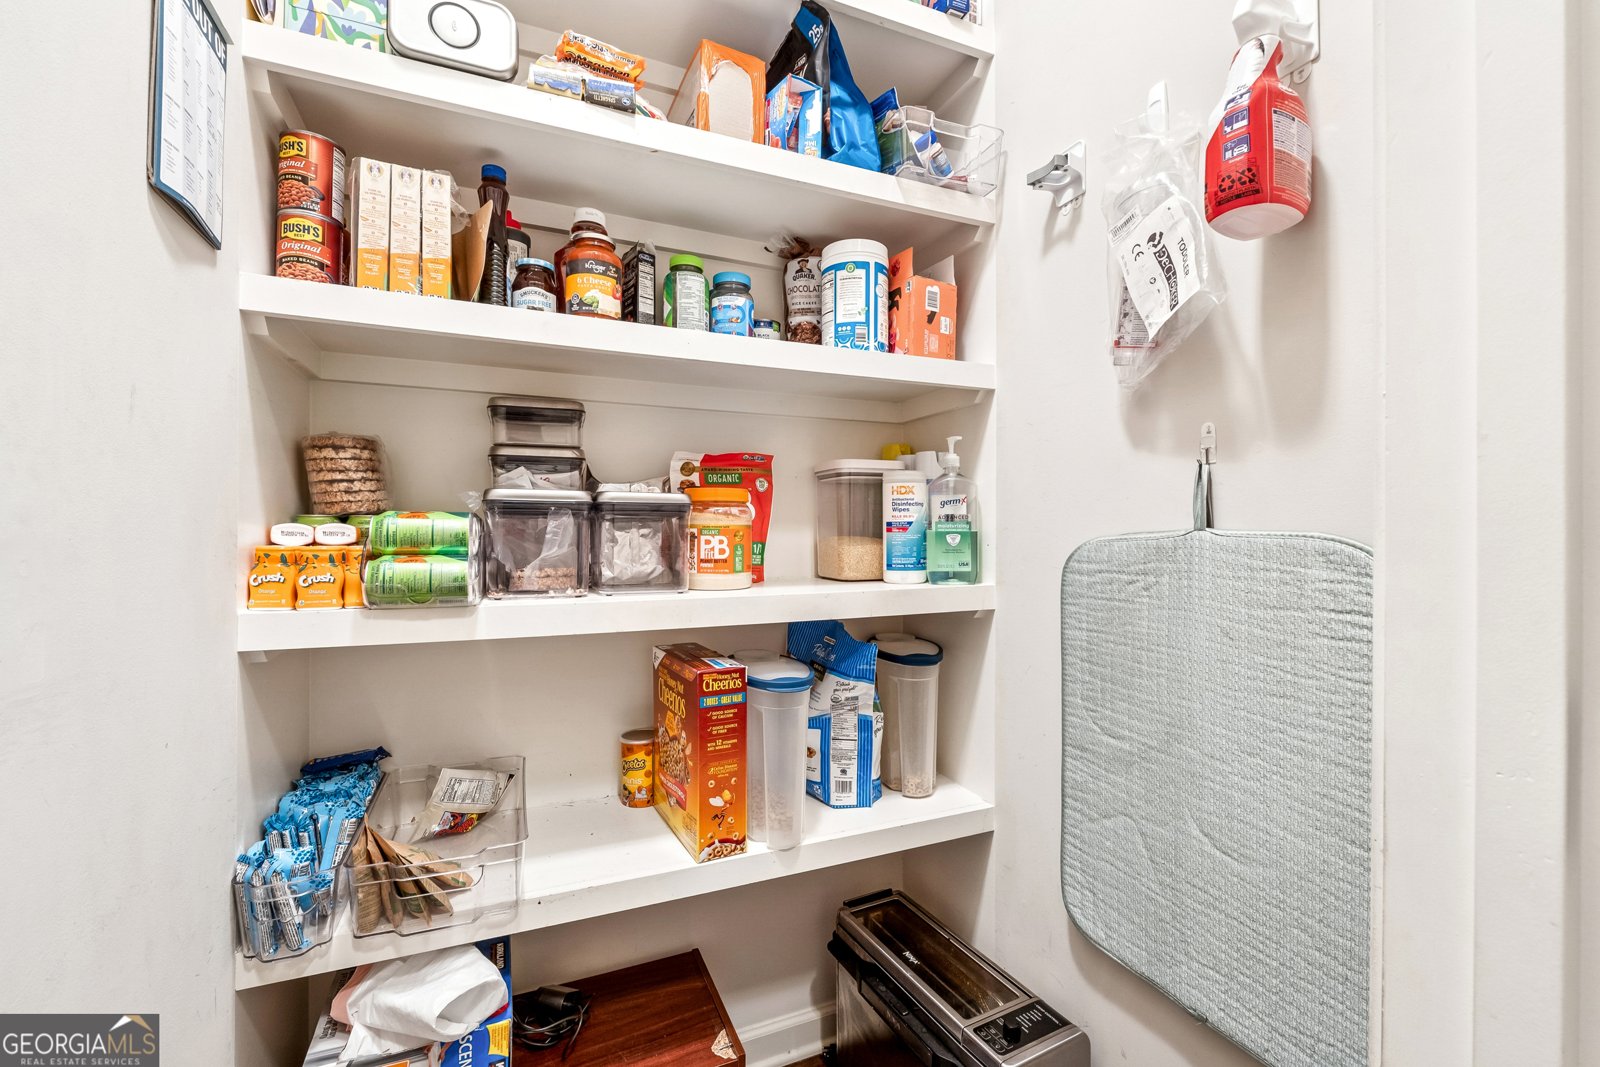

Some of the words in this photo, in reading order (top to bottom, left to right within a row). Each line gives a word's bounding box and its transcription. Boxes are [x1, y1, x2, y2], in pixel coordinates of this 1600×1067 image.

[215, 32, 226, 64] OF
[280, 140, 303, 152] USH'S
[280, 159, 306, 168] iginal
[283, 223, 320, 238] BUSH'S
[281, 241, 321, 253] Original
[1177, 237, 1190, 276] TODDLER
[585, 260, 606, 273] Kroger
[583, 276, 612, 287] Cheese
[792, 272, 816, 281] QUAKER
[787, 284, 820, 295] CHOCOLAT
[538, 300, 552, 308] FREE
[708, 474, 739, 483] ORGANIC
[891, 485, 915, 495] HDX
[249, 572, 285, 587] Crush
[298, 572, 335, 587] Crush
[702, 678, 743, 692] Cheerios
[658, 678, 686, 719] Cheerios
[706, 697, 719, 706] BOXES
[720, 695, 732, 704] GREAT
[732, 693, 743, 703] VALUE
